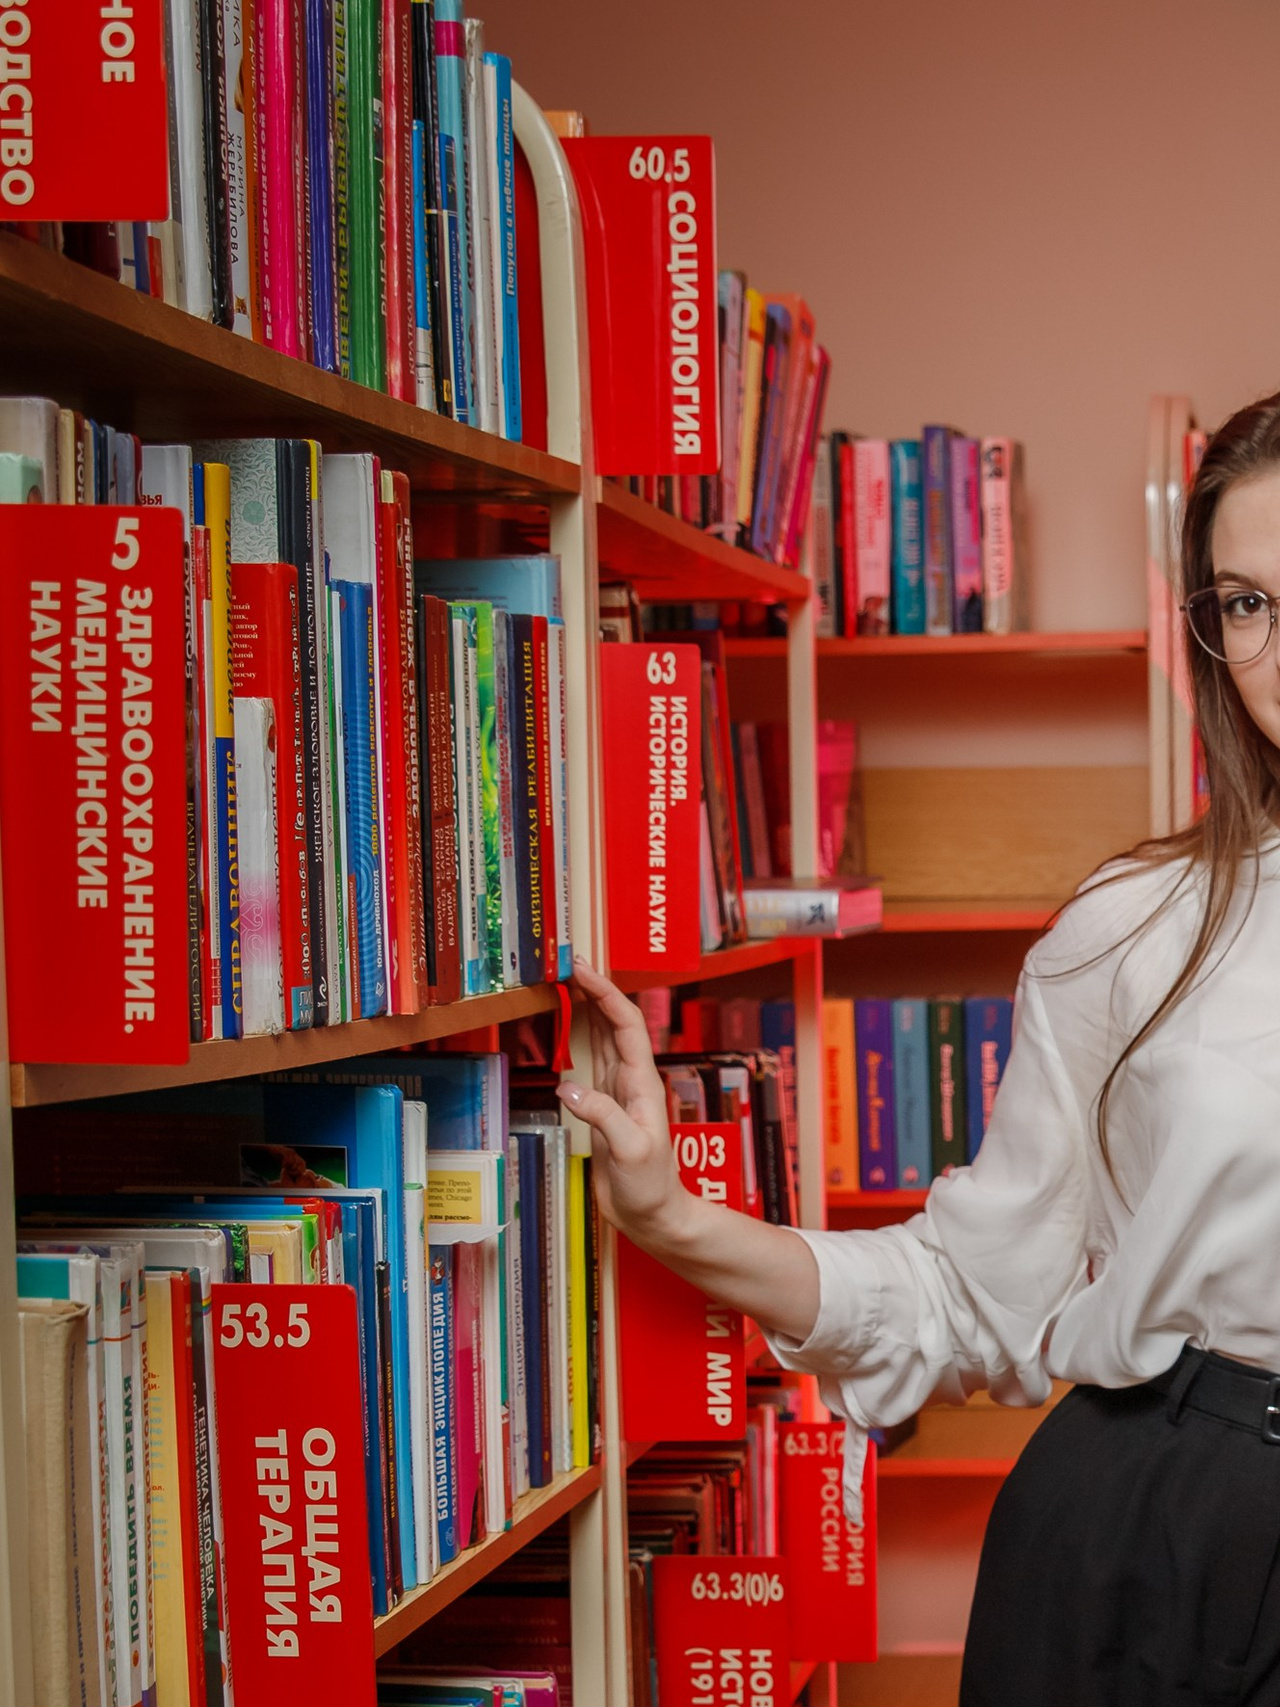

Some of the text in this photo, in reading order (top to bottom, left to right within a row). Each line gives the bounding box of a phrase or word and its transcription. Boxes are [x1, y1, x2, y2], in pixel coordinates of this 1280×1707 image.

[227, 132, 239, 264] ЖЕРЕБИЛОВА
[237, 135, 246, 217] МАРИНА
[257, 14, 273, 340] Всё о персидской кошке
[399, 13, 416, 375] КРАТКАЯ ЭНЦИКЛОПЕДИЯ ПЧЕЛОВОДА
[628, 146, 691, 184] 60.5
[666, 190, 702, 455] СОЦИОЛОГИЯ
[111, 516, 140, 571] 5
[30, 580, 63, 732] НАУКИ
[366, 606, 374, 674] здоровья
[646, 651, 677, 685] 63
[70, 578, 109, 909] МЕДИЦИНСКИЕ
[306, 562, 323, 863] ЖЕНСКОЕ ЗДОРОВЬЕ И ДОЛГОЛЕТИЕ
[367, 691, 377, 755] красоты
[669, 696, 688, 807] ИСТОРИЯ.
[115, 584, 156, 1034] ЗДРАВООХРАНЕНИЕ.
[368, 758, 378, 819] рецептов
[369, 825, 379, 855] 1000
[523, 642, 543, 937] ФИЗИЧЕСКАЯ РЕАБИЛИТАЦИЯ
[648, 695, 667, 953] ИСТОРИЧЕСКИЕ НАУКИ
[185, 802, 202, 1022] ВРАЧЕВАТЕЛИ РОССИИ
[371, 869, 384, 968] Юлия ДРИБНОХОД
[220, 1302, 311, 1349] 53.5
[706, 1351, 732, 1427] МИР
[432, 1292, 449, 1521] БОЛЬШАЯ ЭНЦИКЛОПЕДИЯ
[96, 1401, 112, 1650] ЭРА МОЛОДОСТИ
[122, 1375, 140, 1643] ПОБЕДИТЬ ВРЕМЯ
[198, 1407, 215, 1600] ГЕНЕТИКА ЧЕЛОВЕКА
[254, 1428, 300, 1658] ТЕРАПИЯ
[300, 1427, 343, 1623] ОБЩАЯ
[820, 1467, 841, 1572] РОССИИ
[844, 1514, 865, 1586] ОРИЯ
[691, 1572, 784, 1607] 63.3(0)6
